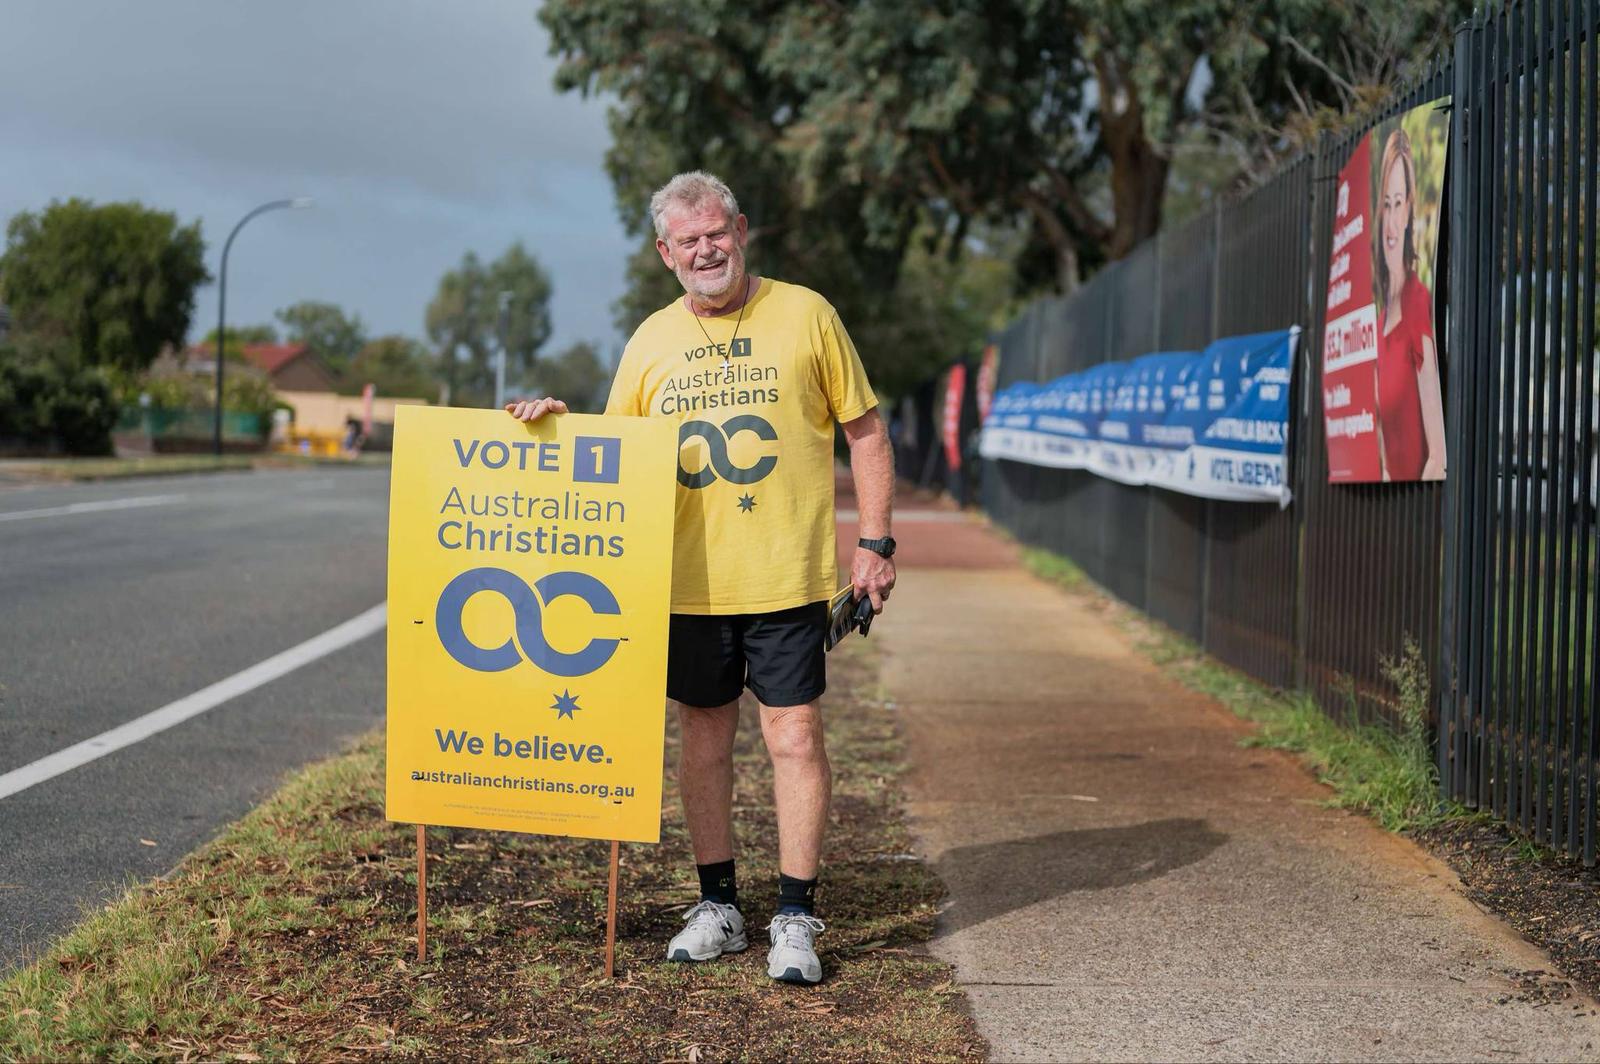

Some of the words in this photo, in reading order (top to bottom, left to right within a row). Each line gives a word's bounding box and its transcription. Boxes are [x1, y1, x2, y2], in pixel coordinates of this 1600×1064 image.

[684, 343, 727, 362] VOTE
[1343, 319, 1375, 356] million
[663, 363, 778, 395] Australian
[661, 387, 779, 415] Christians
[453, 438, 561, 472] VOTE
[440, 486, 625, 523] Australian
[437, 520, 624, 558] Christians
[435, 728, 484, 755] We
[493, 732, 613, 764] believe.
[411, 769, 635, 798] australianchristians.org.au
